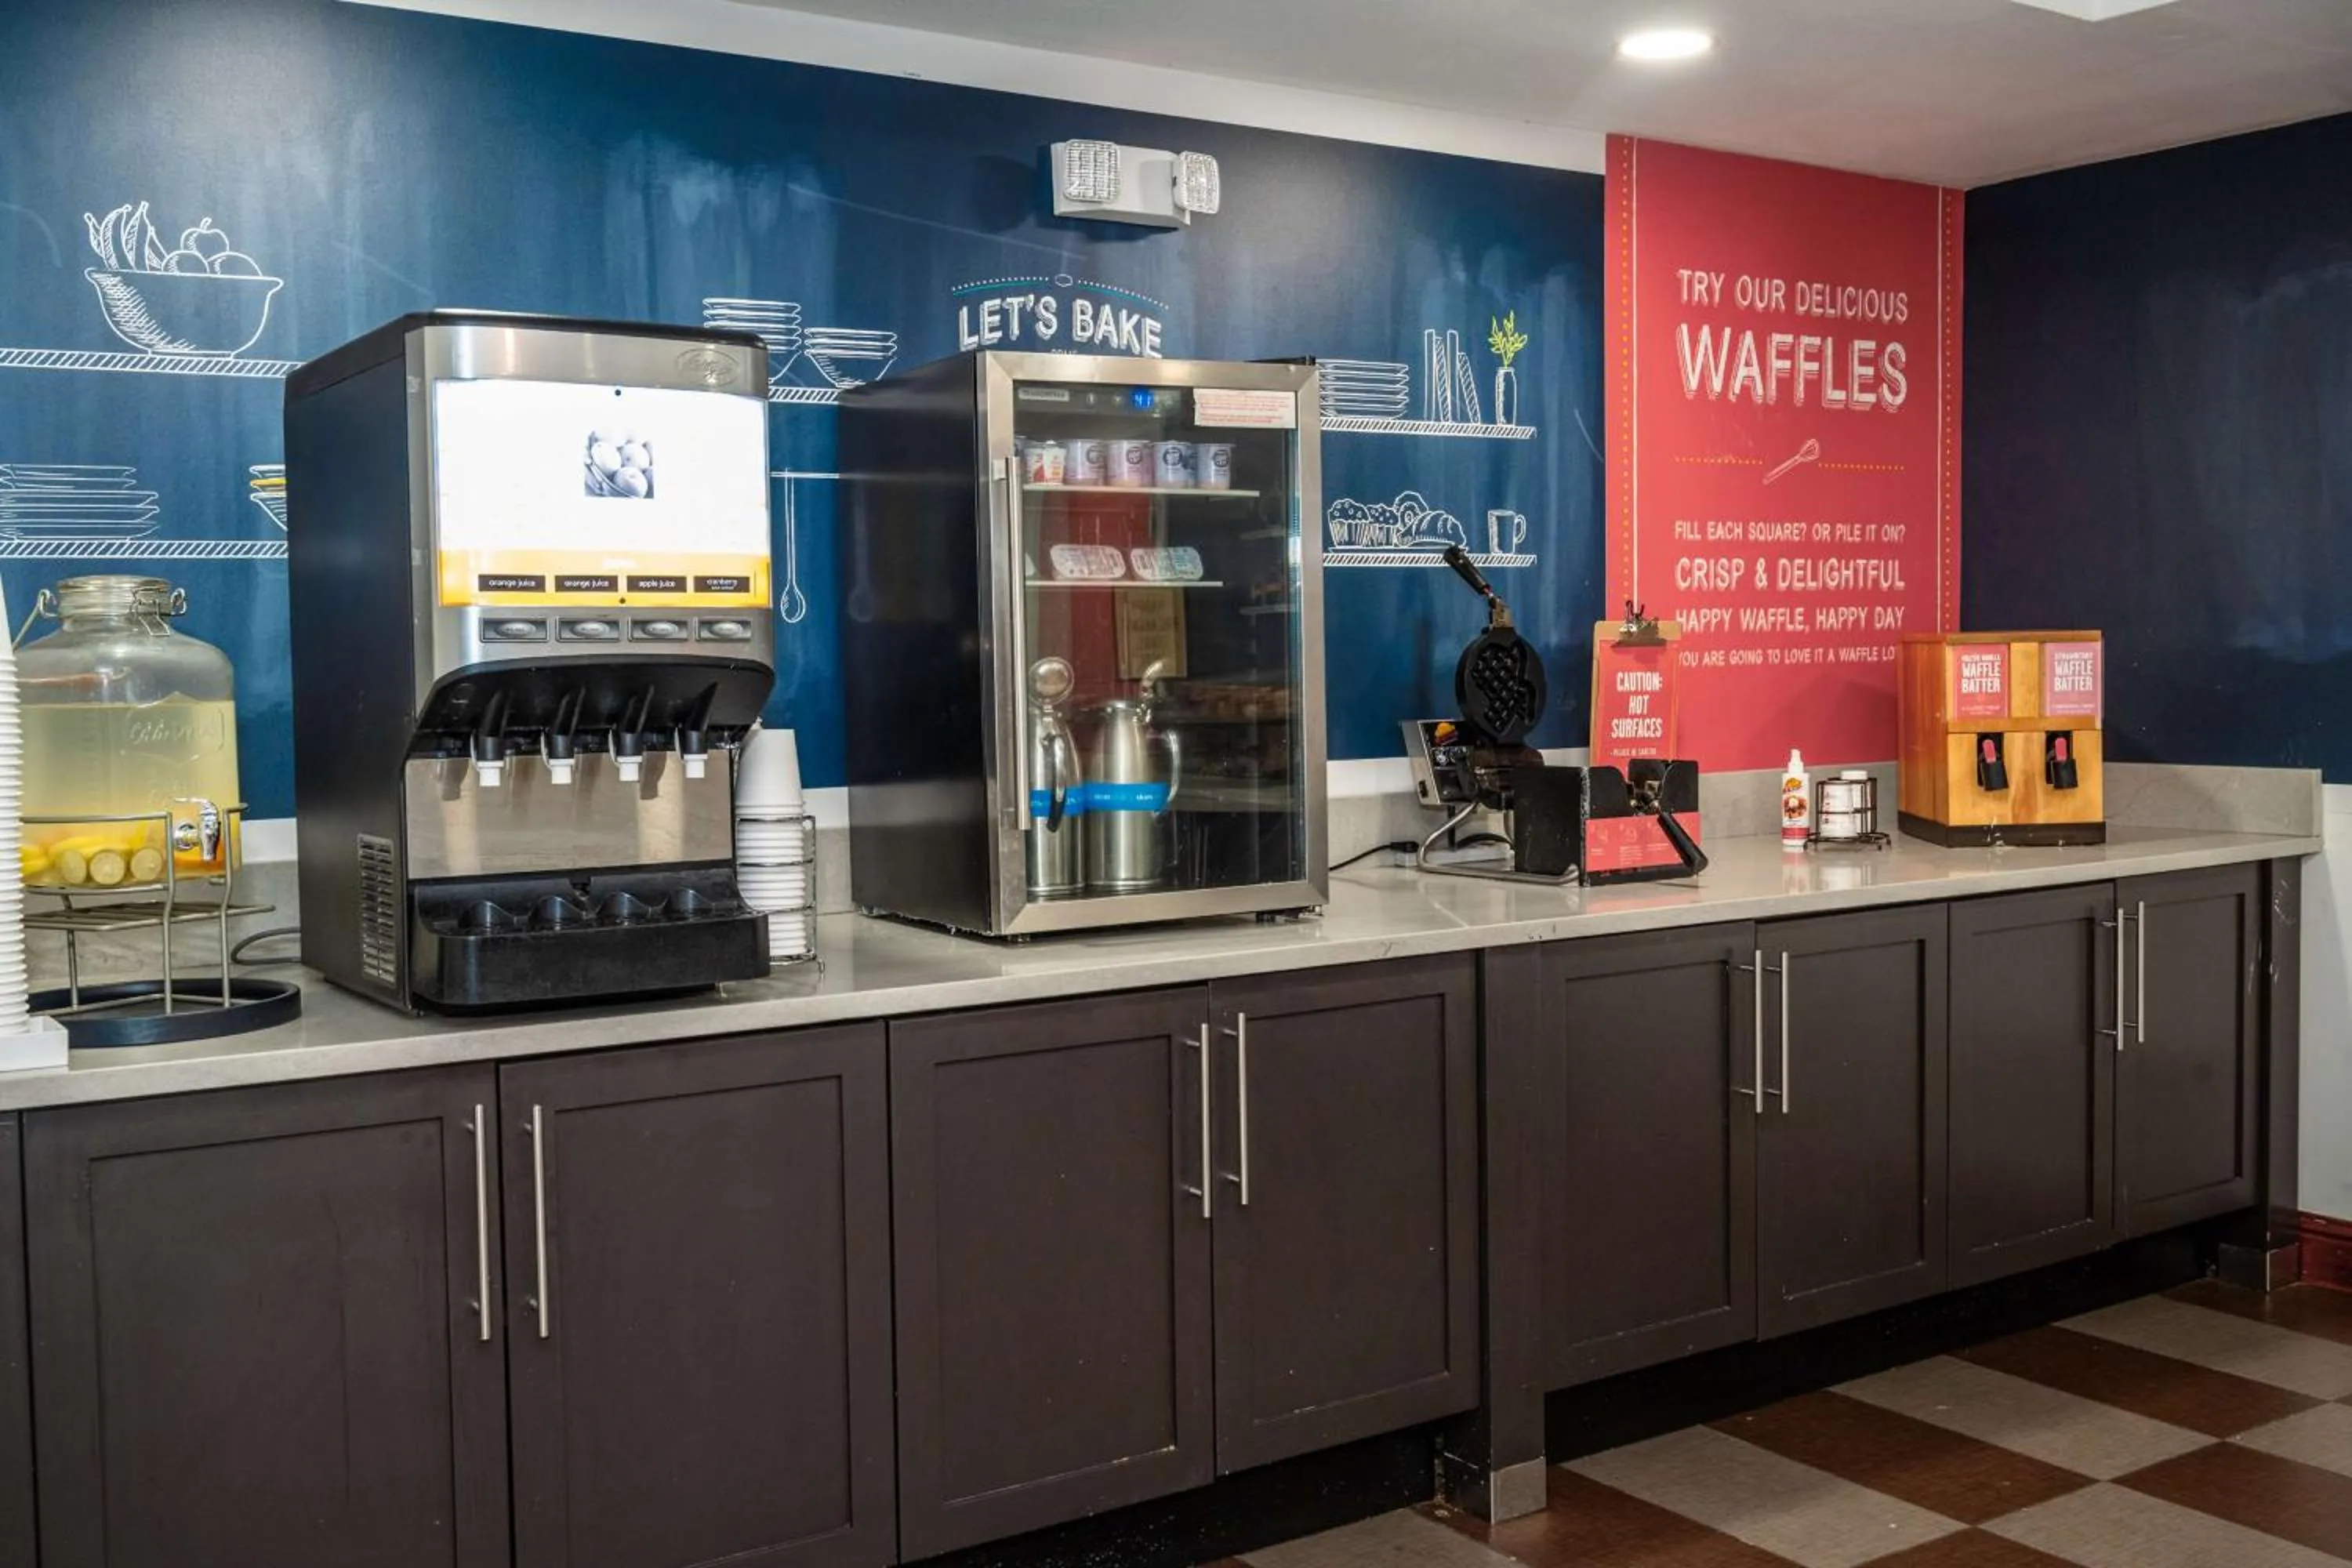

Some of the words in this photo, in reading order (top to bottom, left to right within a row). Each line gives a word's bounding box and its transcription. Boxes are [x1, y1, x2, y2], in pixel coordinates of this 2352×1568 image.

[1677, 269, 1725, 307] TRY
[1734, 274, 1786, 313] OUR
[1795, 281, 1908, 324] DELICIOUS
[959, 294, 1058, 352] LET'S
[1072, 298, 1163, 358] BAKE
[1676, 323, 1908, 413] WAFFLES
[1675, 520, 1701, 539] FILL
[1707, 521, 1743, 541] EACH
[1748, 521, 1806, 543] SQUARE?
[1812, 523, 1831, 543] OR
[1835, 524, 1860, 543] PILE
[1865, 524, 1876, 543] IT
[1882, 524, 1906, 544] ON?
[1675, 557, 1744, 590] CRISP
[1755, 557, 1768, 590] &
[1777, 557, 1905, 591] DELIGHTFUL
[1675, 607, 1732, 631] HAPPY
[1740, 607, 1809, 633] WAFFLE,
[1816, 607, 1867, 630] HAPPY
[1874, 606, 1904, 630] DAY
[1702, 650, 1726, 666] ARE
[1730, 649, 1763, 665] GOING
[1768, 648, 1780, 663] TO
[1784, 648, 1811, 663] LOVE
[1814, 648, 1824, 662] IT
[1828, 648, 1835, 662] A
[1838, 646, 1878, 662] WAFFLE
[1882, 645, 1895, 661] LO
[1962, 661, 2002, 678] WAFFLE
[2054, 659, 2093, 676] WAFFLE
[1617, 671, 1663, 691] CAUTION:
[1962, 677, 2002, 694] BATTER
[2054, 676, 2093, 691] BATTER
[1628, 695, 1650, 716] HOT
[1611, 717, 1662, 739] SURFACES
